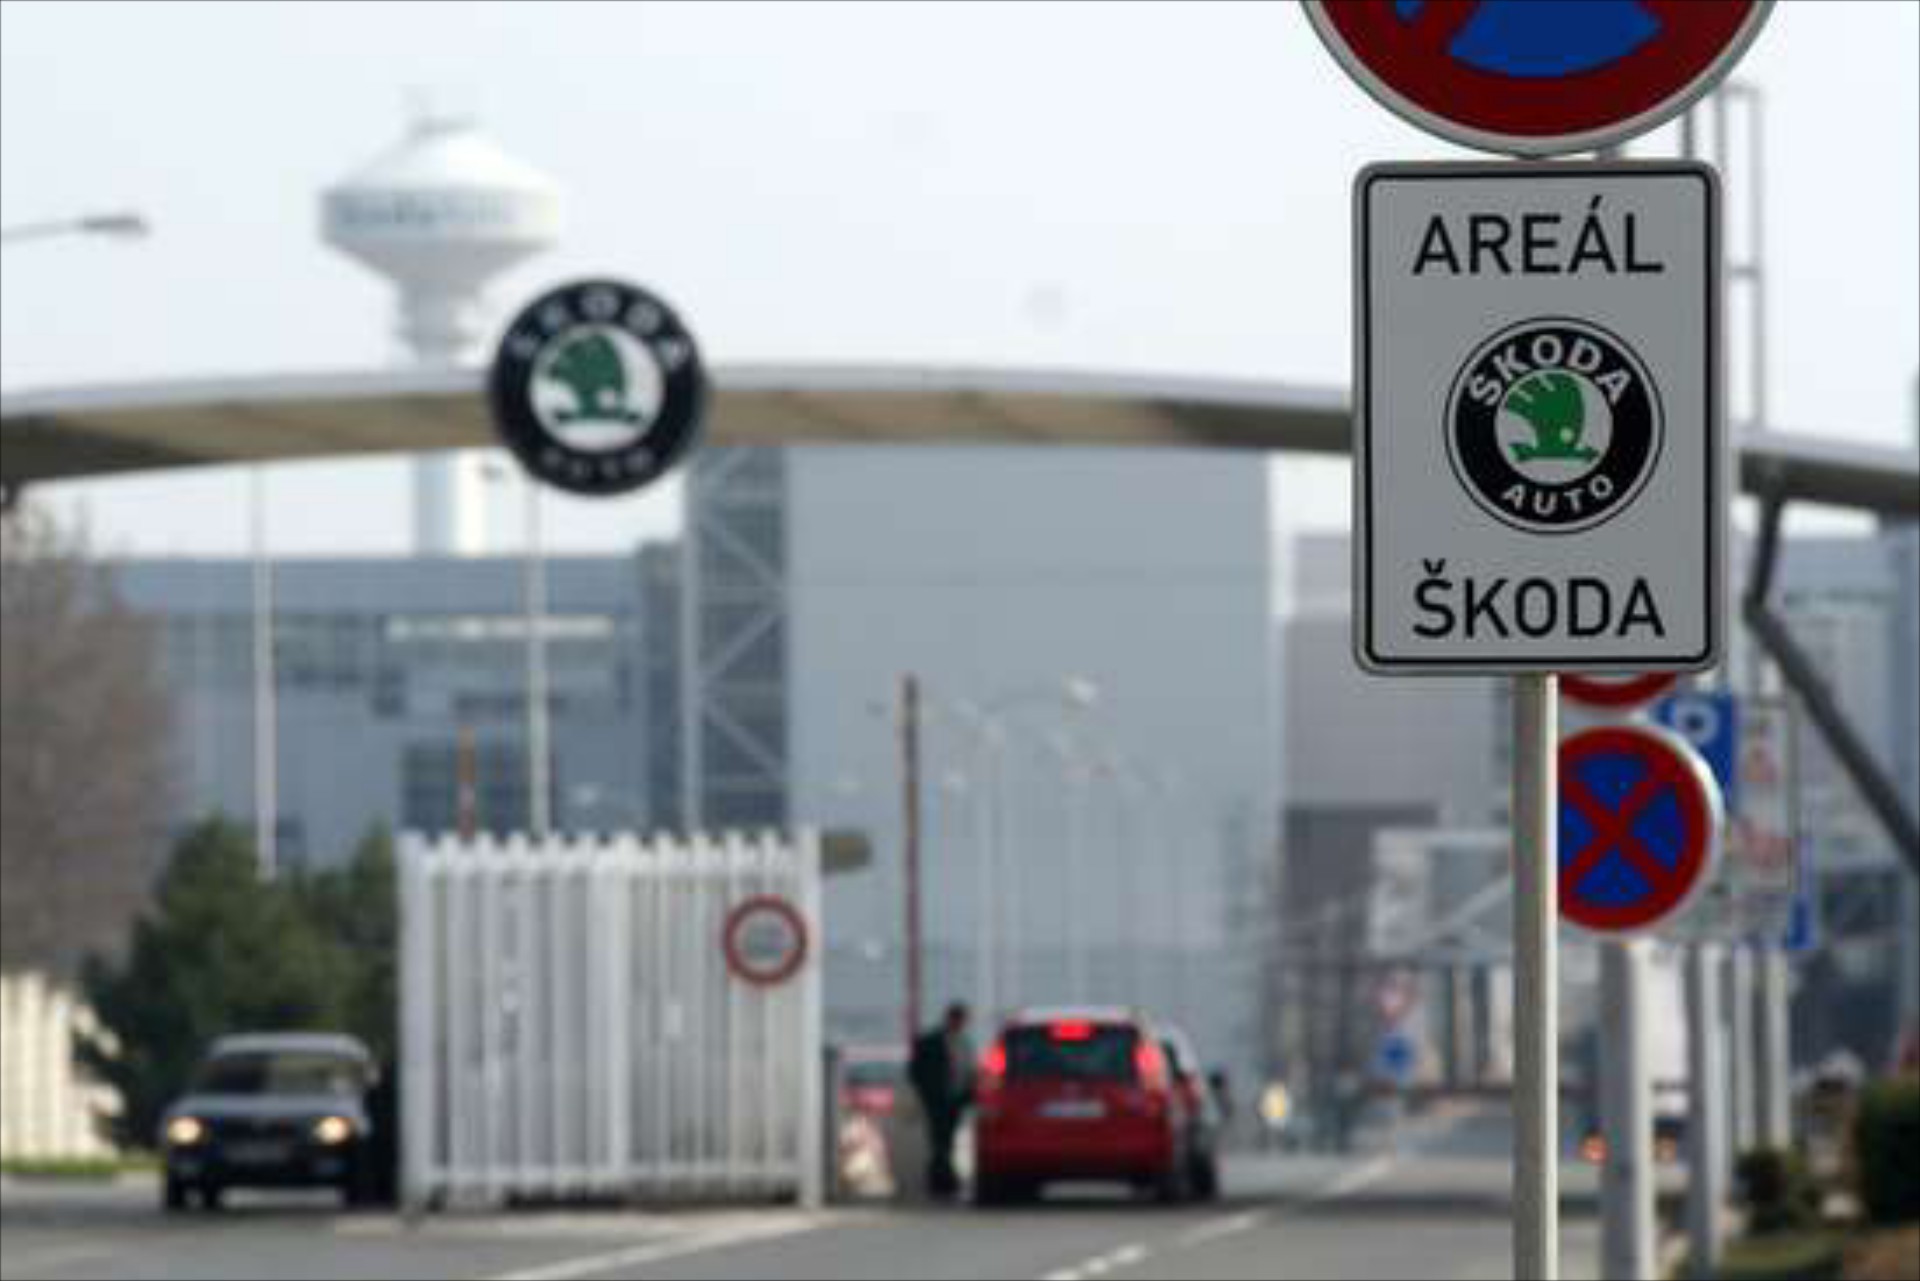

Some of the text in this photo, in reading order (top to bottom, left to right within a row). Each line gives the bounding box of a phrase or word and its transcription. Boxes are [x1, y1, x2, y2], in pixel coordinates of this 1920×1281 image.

[1413, 195, 1665, 275] AREÁL
[1502, 474, 1614, 515] AUTO
[1412, 558, 1666, 639] ŠKODA
